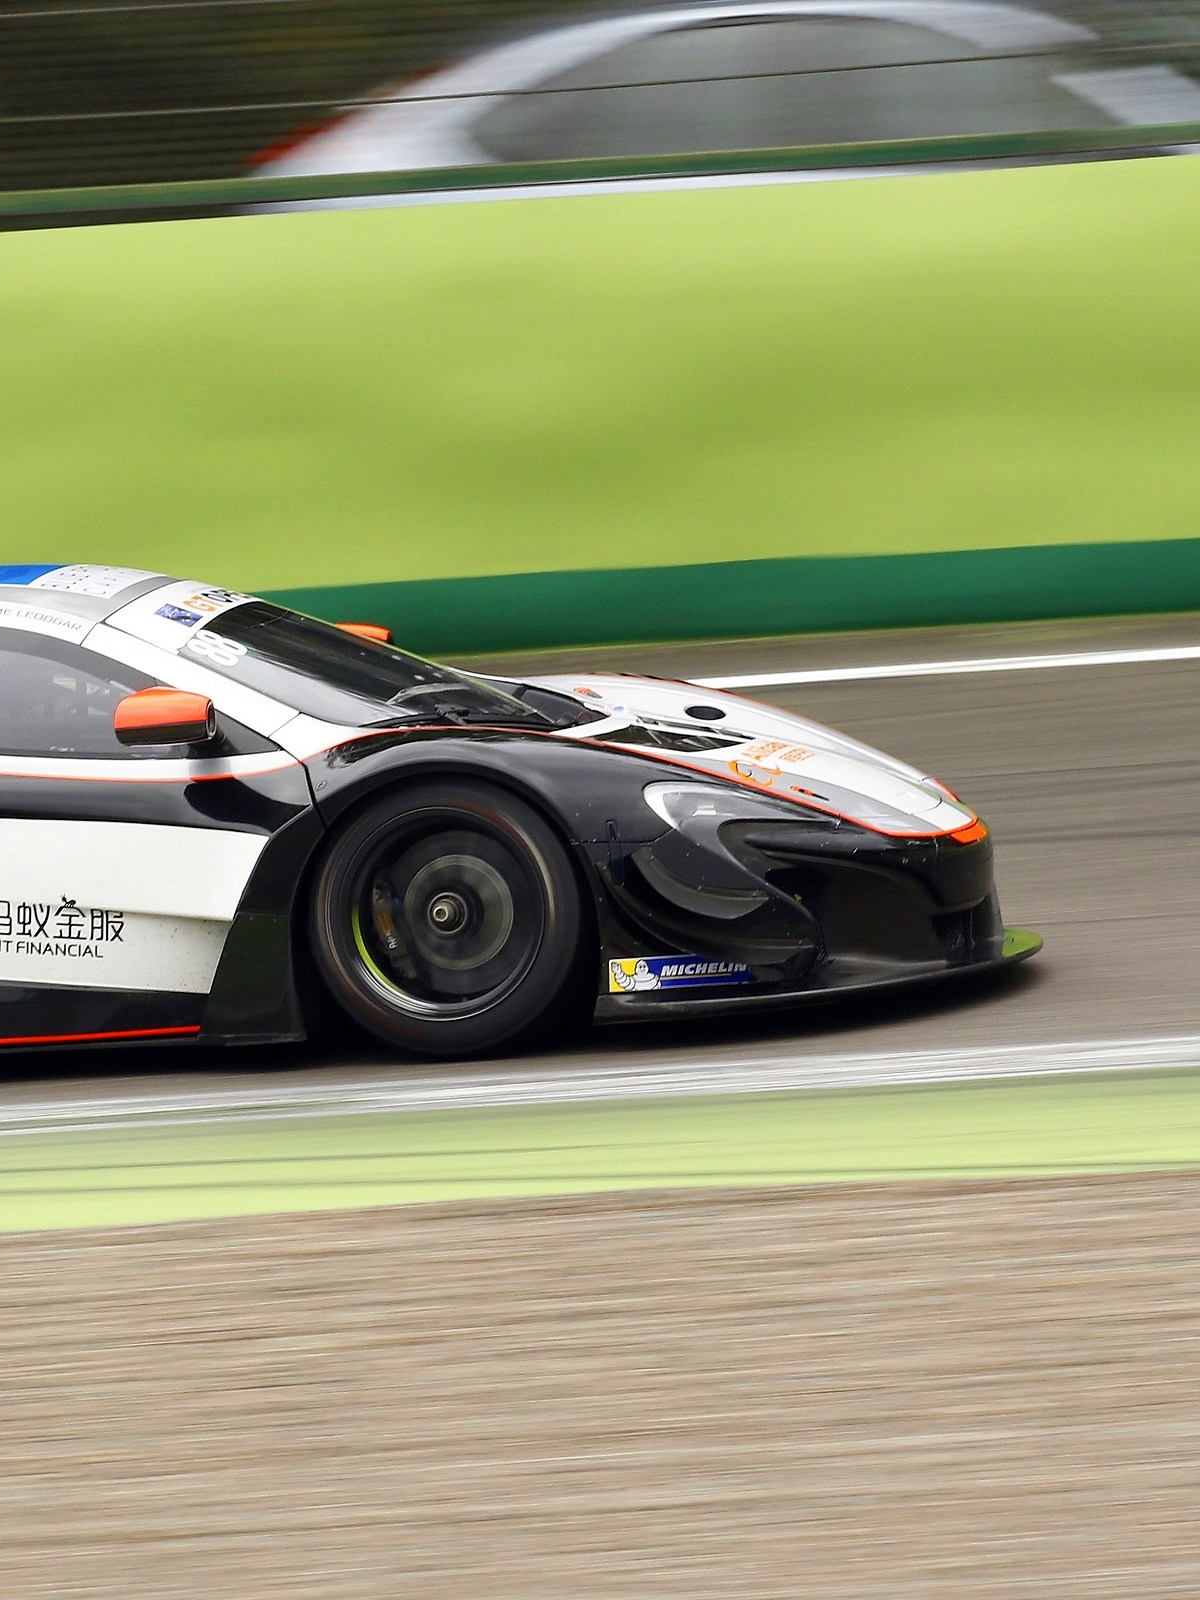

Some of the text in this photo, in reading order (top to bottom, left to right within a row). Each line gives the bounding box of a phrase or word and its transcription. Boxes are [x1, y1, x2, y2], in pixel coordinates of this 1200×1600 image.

[186, 629, 248, 667] 88
[15, 941, 104, 959] FINANCIAL
[661, 961, 748, 978] MICHELIN
